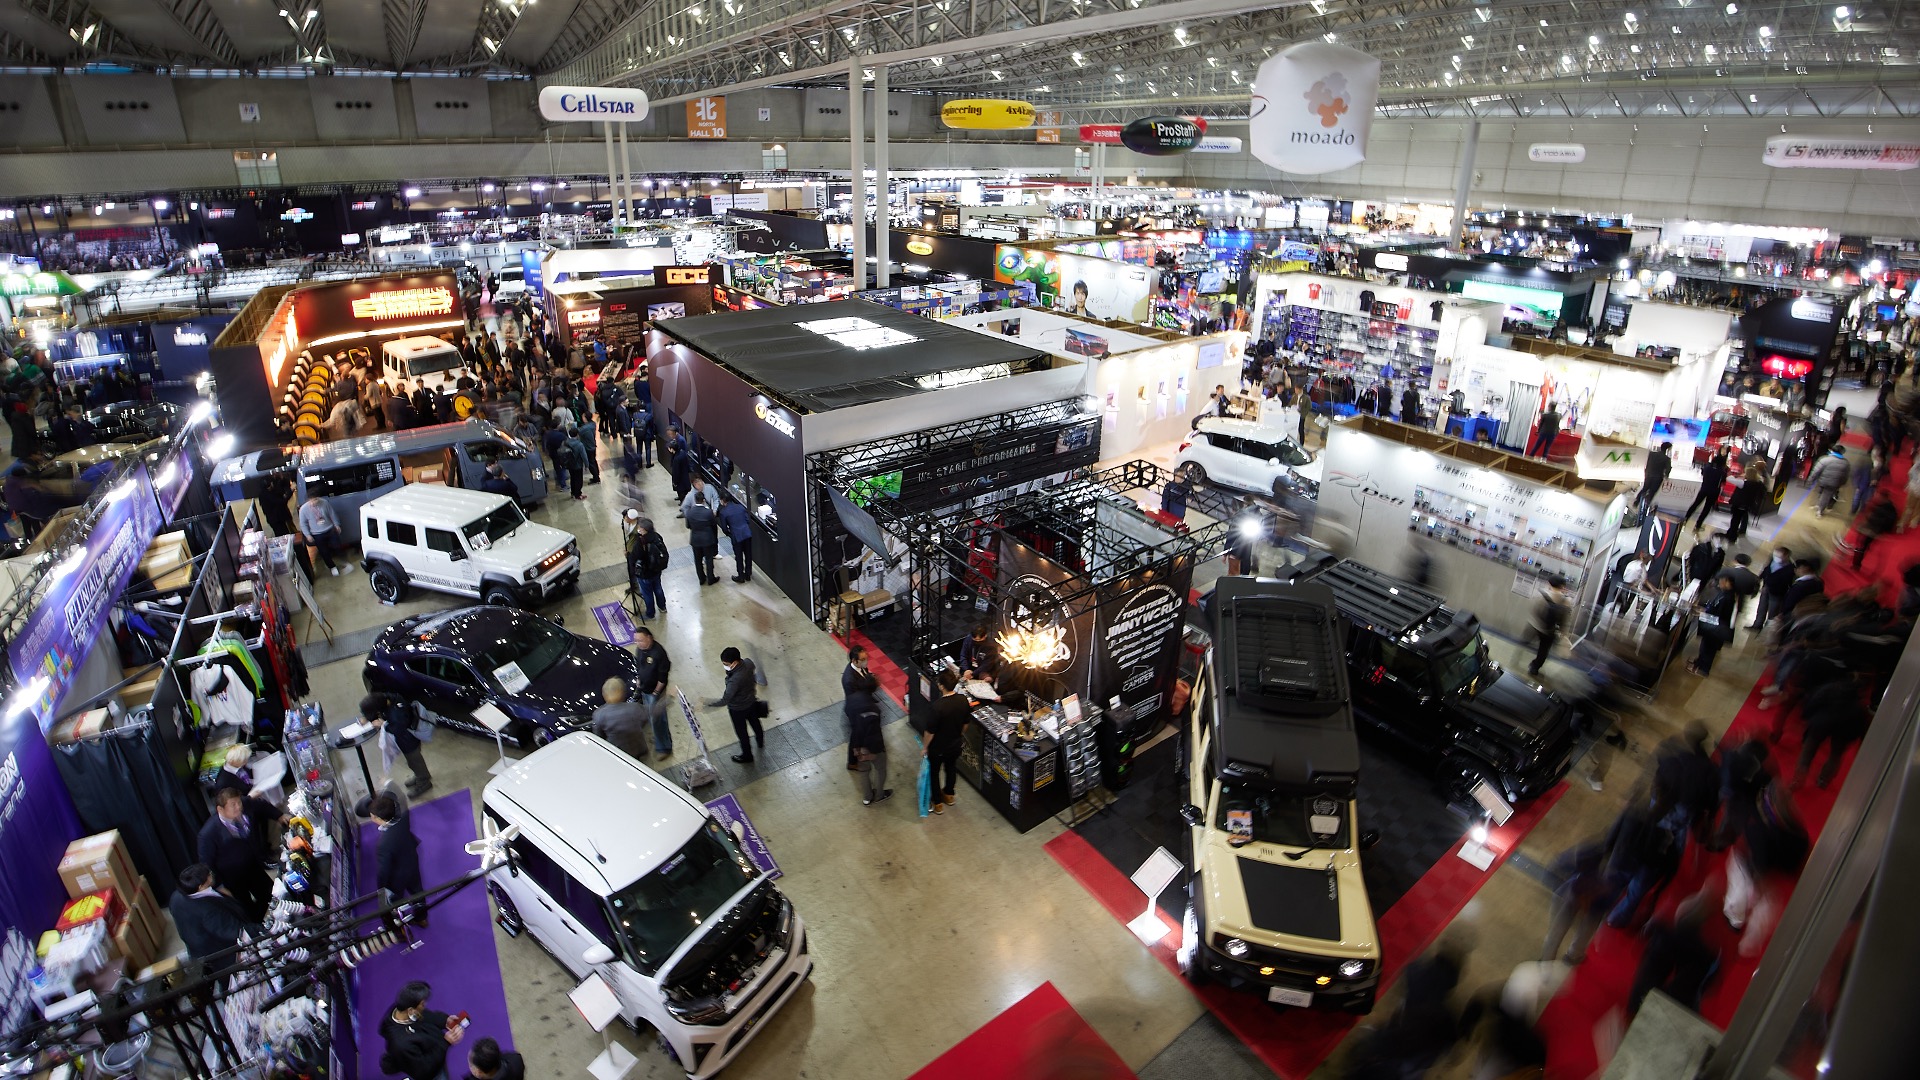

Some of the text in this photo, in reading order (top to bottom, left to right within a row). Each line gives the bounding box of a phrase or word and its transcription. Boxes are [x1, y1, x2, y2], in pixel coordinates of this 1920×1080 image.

[695, 97, 717, 121] 北
[712, 127, 725, 137] 10
[1291, 129, 1355, 146] moado
[666, 268, 709, 284] GCG
[1105, 597, 1182, 640] JIMNYWORLD
[1122, 605, 1145, 620] TOYO
[1123, 671, 1154, 692] CAMPER
